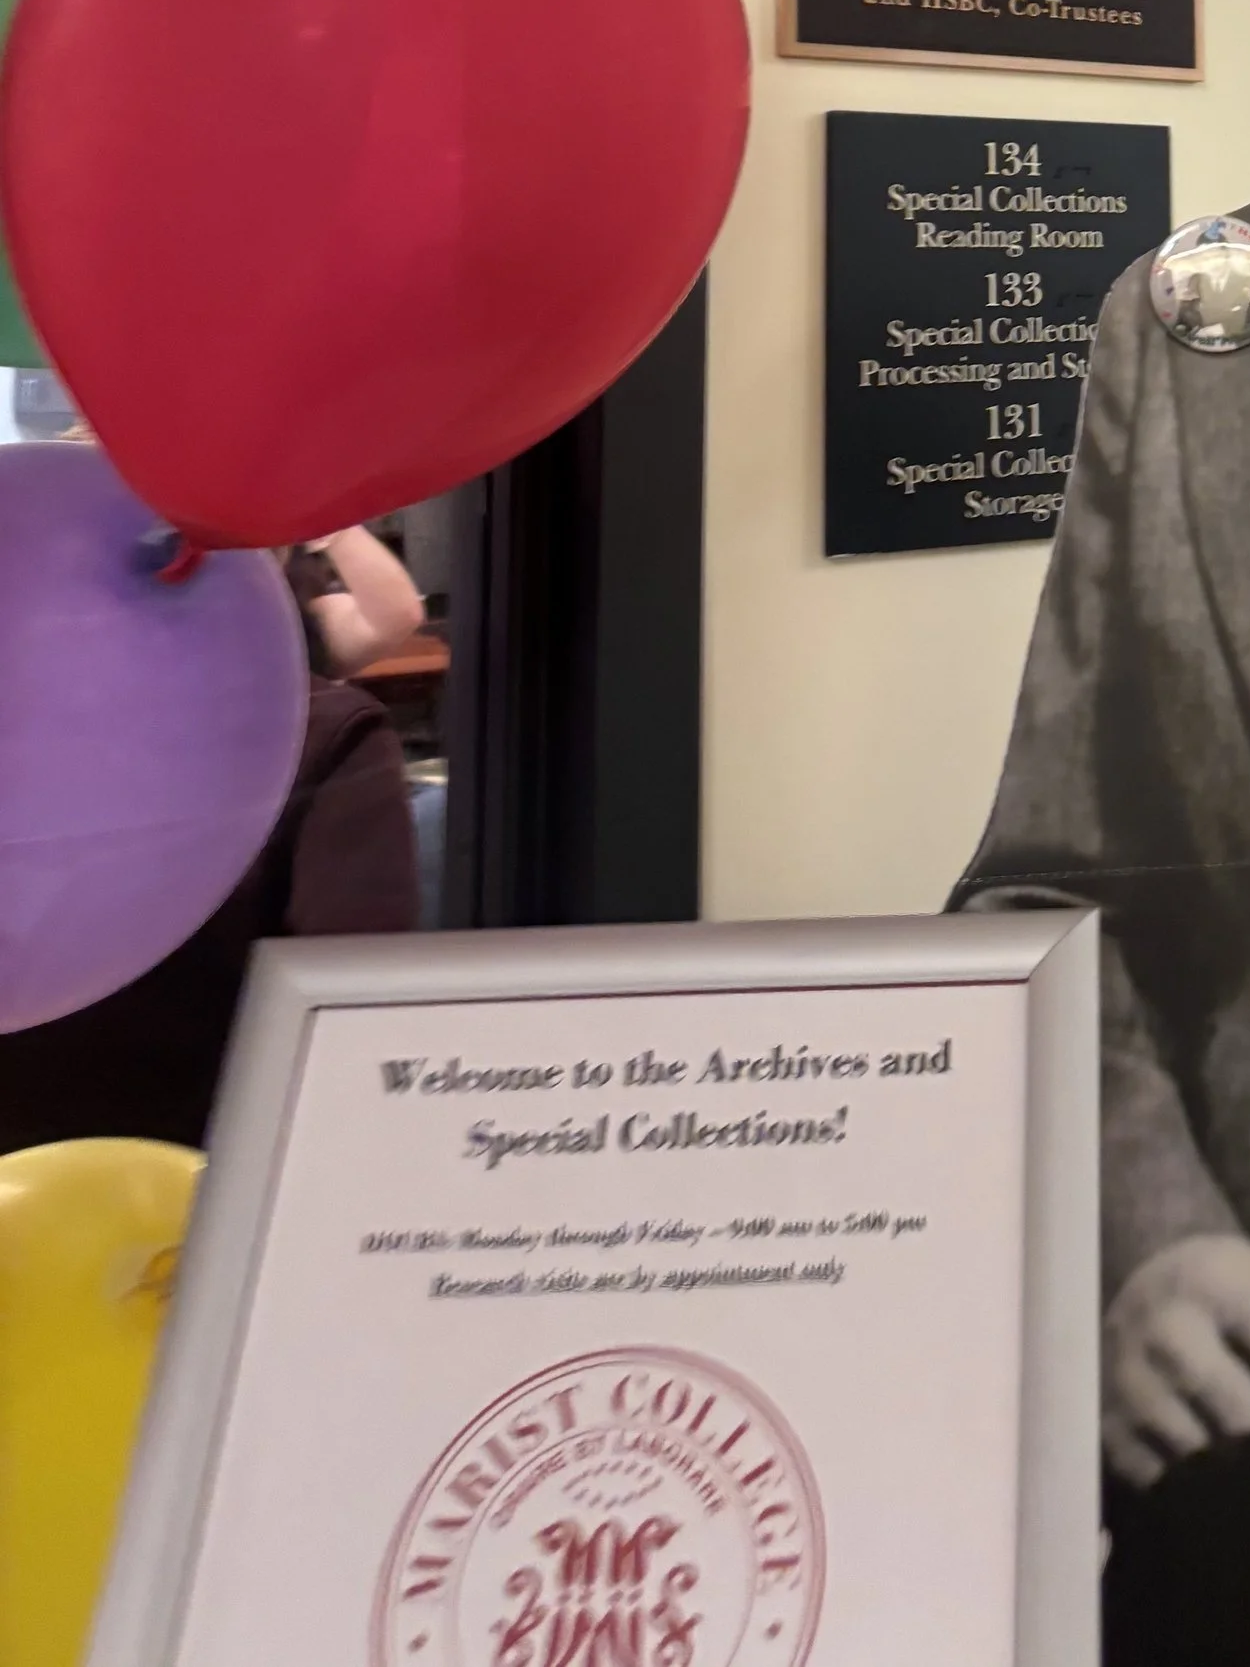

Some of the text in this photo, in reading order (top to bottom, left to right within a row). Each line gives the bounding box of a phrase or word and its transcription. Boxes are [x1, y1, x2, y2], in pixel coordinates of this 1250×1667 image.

[984, 141, 1043, 177] 134
[886, 183, 1128, 220] Special Collections
[915, 222, 1105, 258] Reading Room
[984, 272, 1044, 308] 133
[886, 316, 1099, 356] Special Collectio
[858, 356, 1003, 392] Processing
[1006, 352, 1056, 382] and
[985, 403, 1044, 440] 131
[886, 447, 1076, 495] Special Collec
[963, 489, 1066, 522] Storage
[380, 1038, 953, 1096] Welcome to the Archives and
[461, 1105, 850, 1170] Special Collections!
